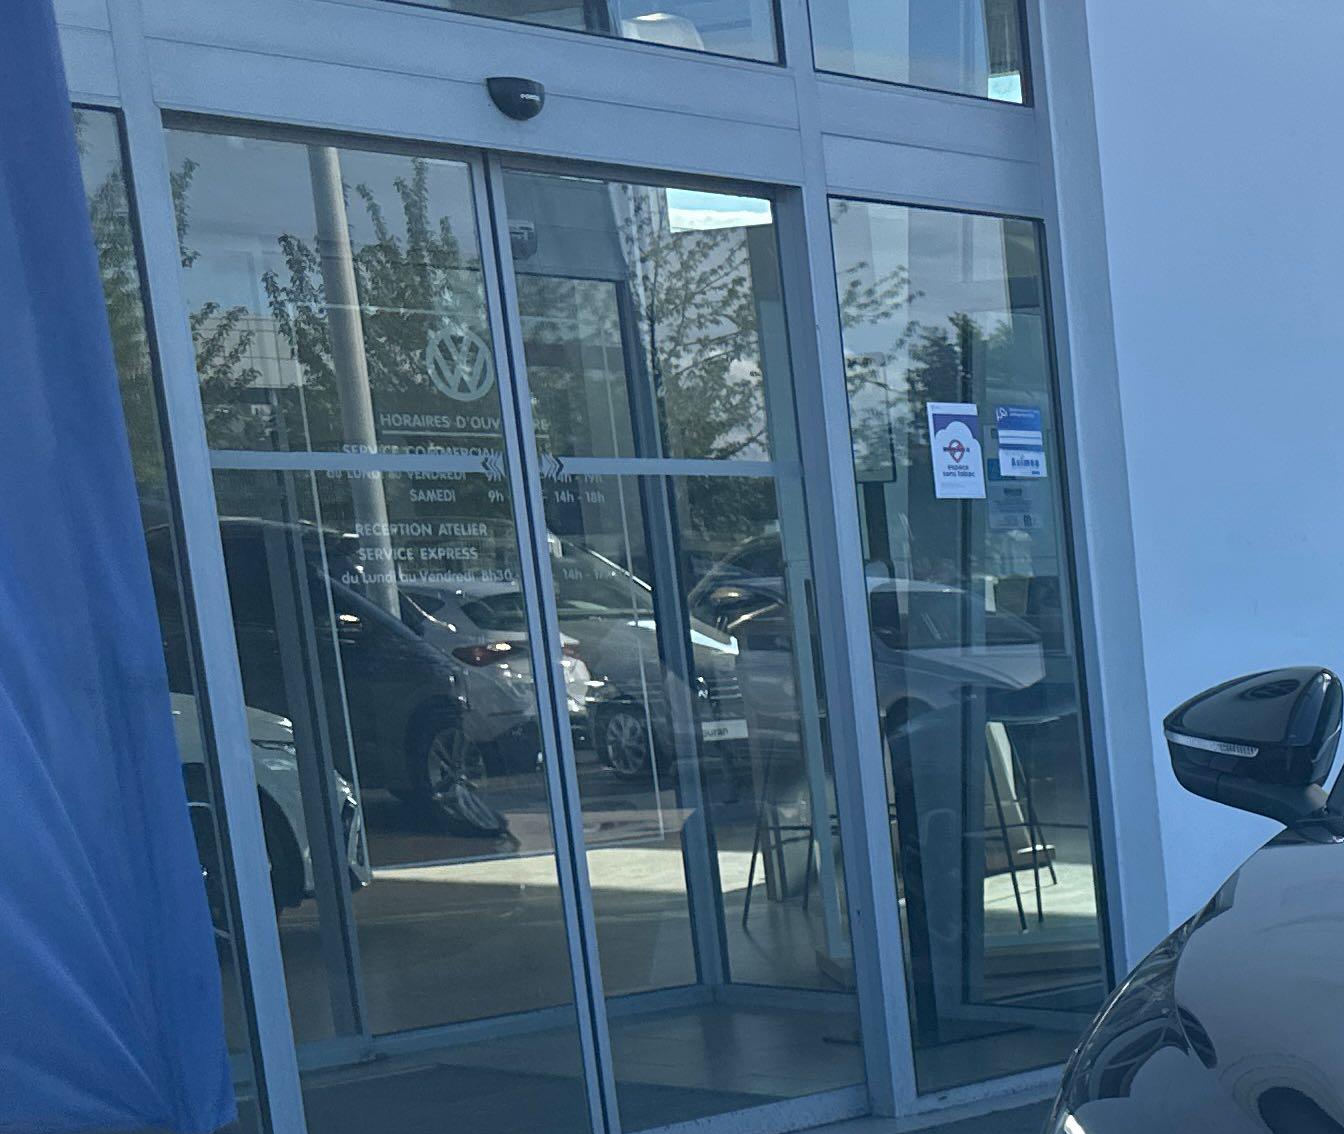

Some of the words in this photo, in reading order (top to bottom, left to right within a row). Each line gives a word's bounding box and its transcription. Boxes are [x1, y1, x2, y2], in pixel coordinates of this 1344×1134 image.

[380, 413, 451, 429] HORAIRES
[409, 489, 456, 503] SAMEDI
[487, 489, 504, 503] 9h
[356, 523, 433, 536] RECEPTION
[438, 523, 488, 536] ATELIER
[359, 547, 415, 561] SERVICE
[420, 547, 479, 560] EXPRESS
[341, 571, 360, 584] du
